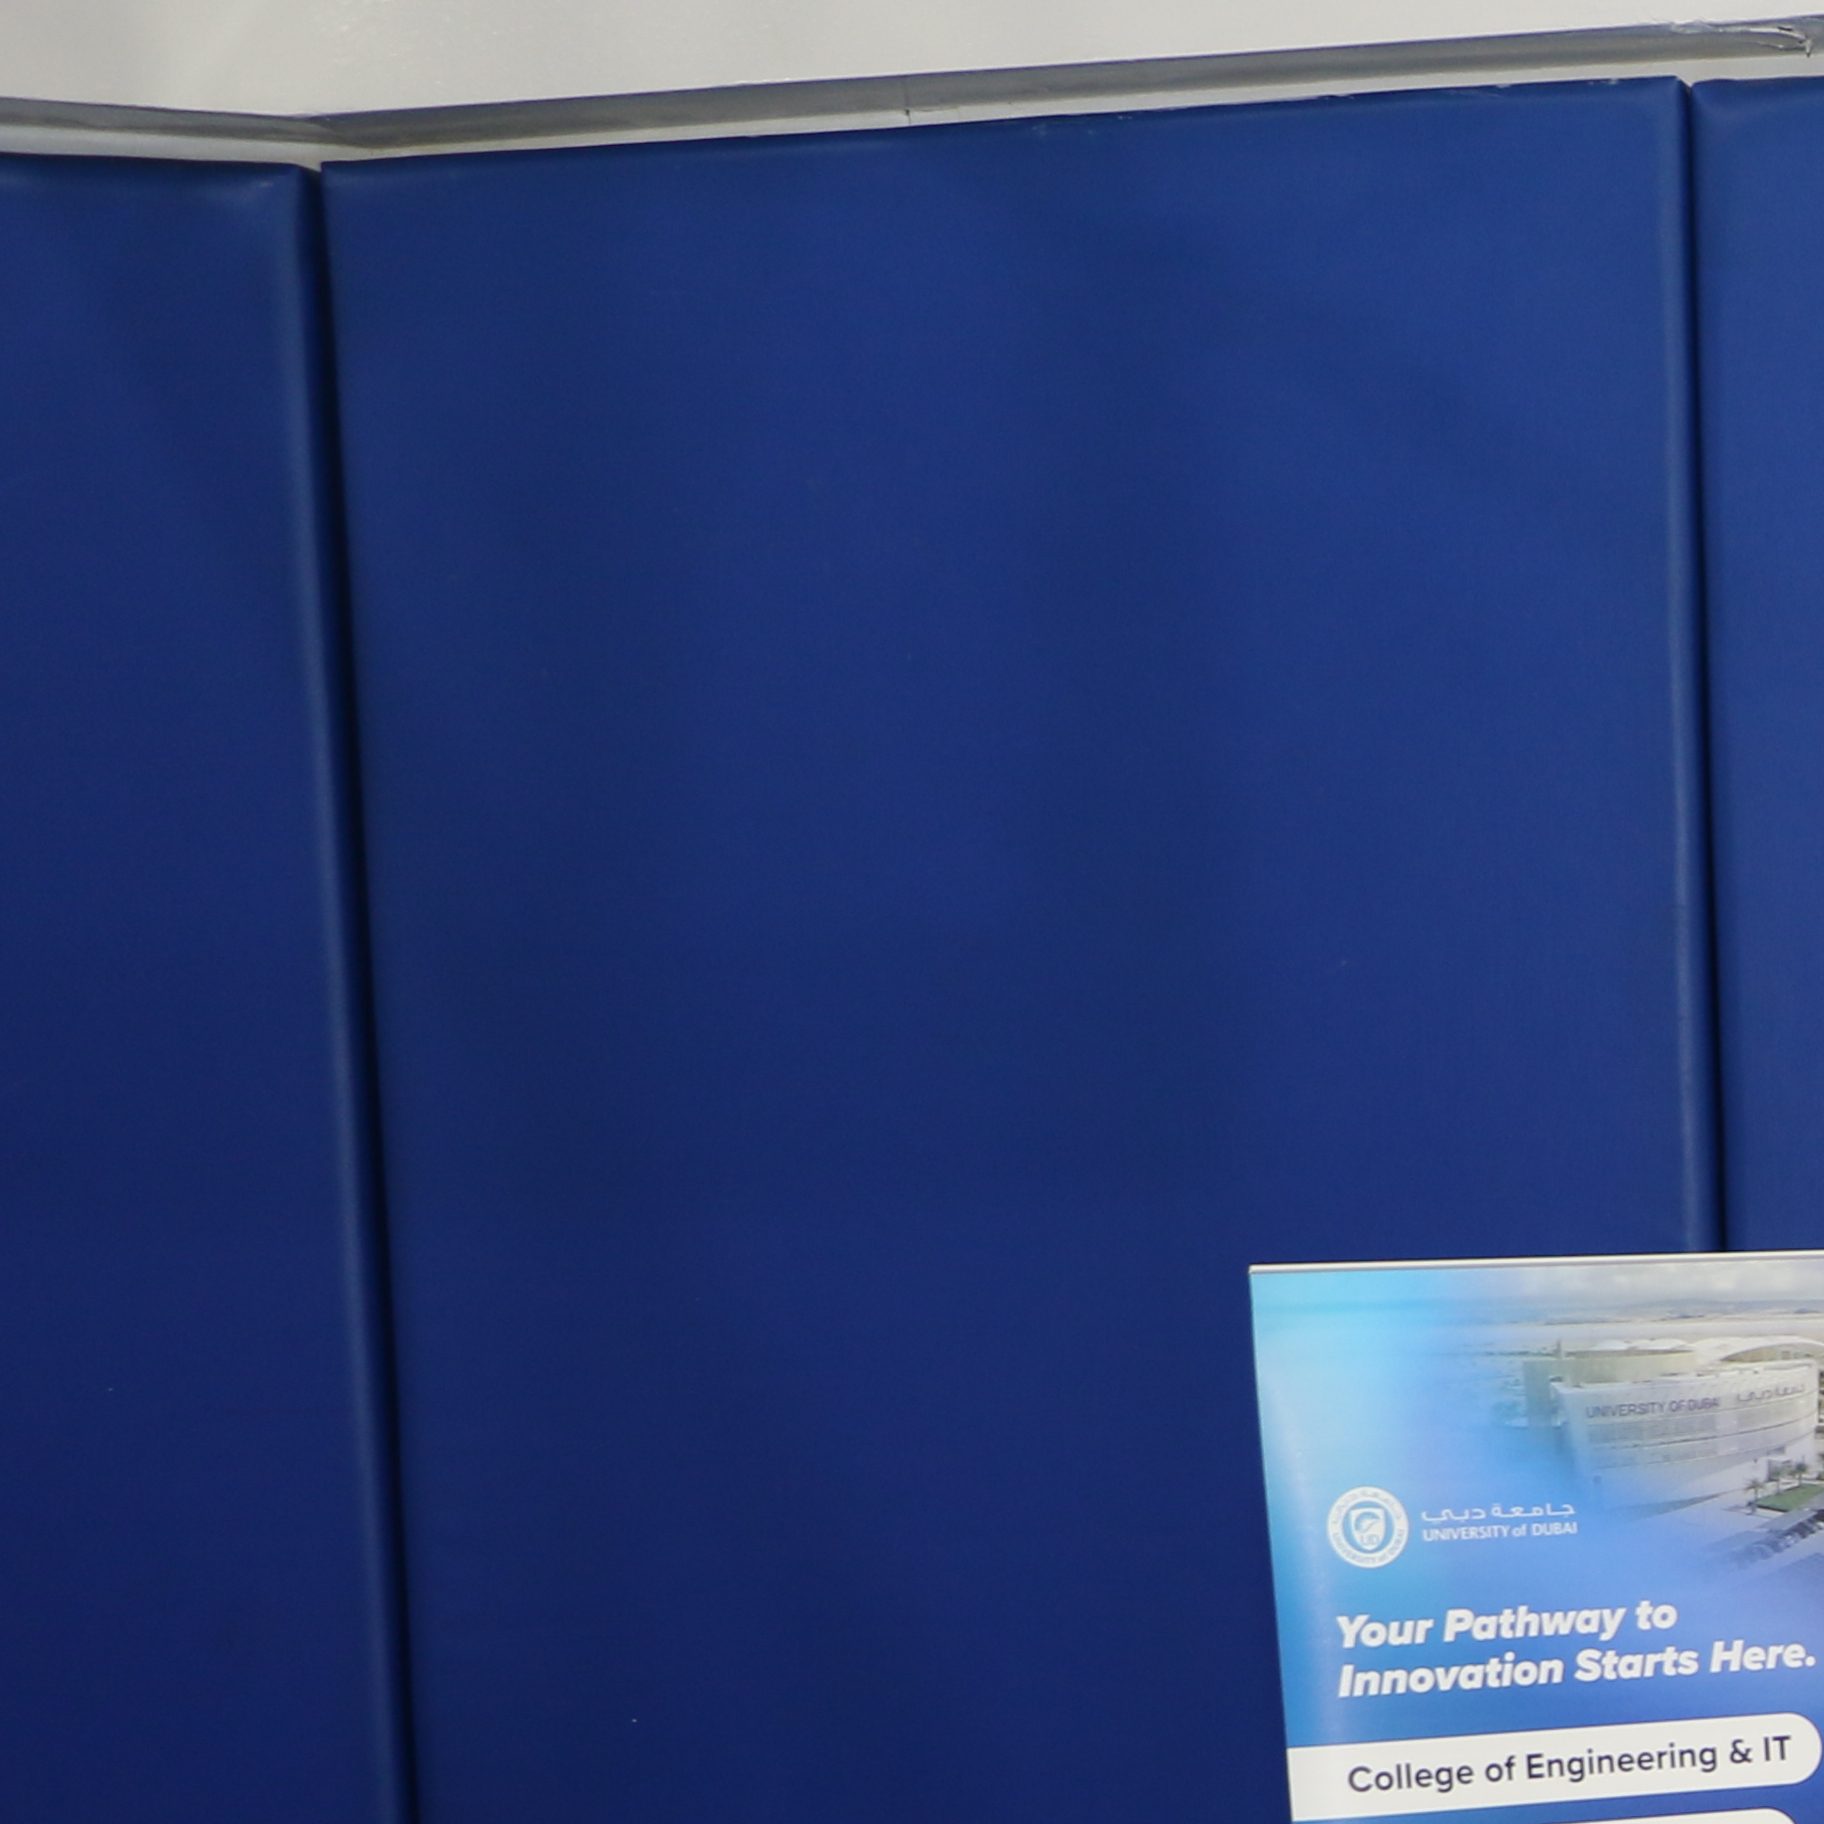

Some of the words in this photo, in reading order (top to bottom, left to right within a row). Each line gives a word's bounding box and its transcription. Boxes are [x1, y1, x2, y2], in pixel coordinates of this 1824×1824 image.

[1421, 1508, 1487, 1524] دبي
[1491, 1503, 1575, 1519] جامعة
[1422, 1526, 1509, 1542] UNIVERSITY
[1512, 1524, 1527, 1537] of
[1532, 1521, 1578, 1536] DUBAI
[1337, 1614, 1433, 1648] Your
[1443, 1606, 1627, 1643] Pathway
[1636, 1600, 1678, 1630] to
[1338, 1652, 1564, 1698] Innovation
[1575, 1647, 1700, 1682] Starts
[1710, 1640, 1817, 1674] Here.
[1348, 1763, 1475, 1793] College
[1485, 1756, 1516, 1781] of
[1526, 1742, 1719, 1782] Engineering
[1729, 1739, 1753, 1764] &
[1763, 1735, 1792, 1762] IT
